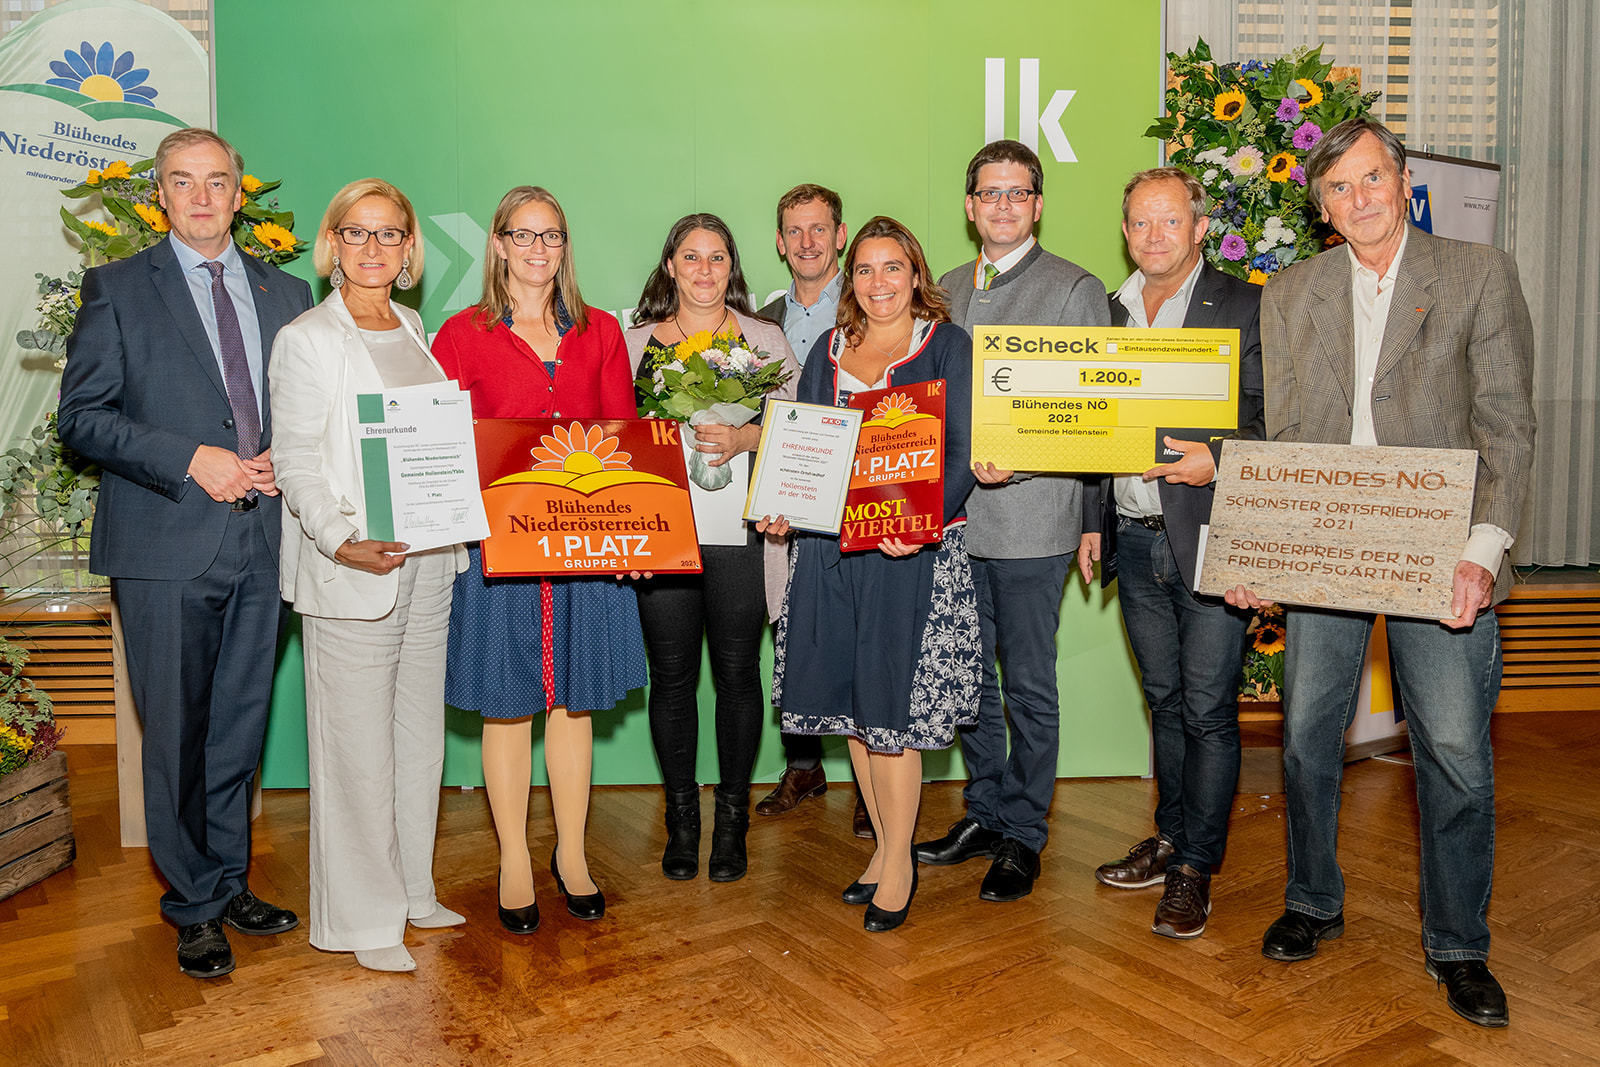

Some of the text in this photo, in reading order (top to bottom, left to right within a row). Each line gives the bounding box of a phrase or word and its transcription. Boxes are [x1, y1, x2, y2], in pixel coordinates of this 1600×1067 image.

[53, 120, 137, 151] Blühendes
[1005, 336, 1099, 354] Scheck
[1080, 371, 1140, 386] 1.200,-
[1012, 398, 1108, 411] Blühendes NÖ
[1048, 413, 1079, 424] 2021
[365, 426, 418, 435] Ehrenurkunde
[651, 421, 678, 445] lk
[871, 430, 917, 444] Blühendes
[1017, 427, 1108, 437] Gemeinde Hollenstein
[782, 442, 833, 456] EHRENURKUNDE
[868, 470, 915, 482] GRUPPE 1
[1240, 465, 1446, 491] BLÜHENDES NÖ
[780, 481, 818, 493] Hollenstein
[801, 492, 817, 501] Ybbs
[546, 500, 632, 514] Blühendes
[844, 498, 907, 522] MOST
[1326, 502, 1454, 521] ORTSFRIEDHOF
[508, 514, 671, 534] Niederösterreich
[843, 513, 939, 540] VIERTEL
[1312, 517, 1354, 530] 2021
[537, 535, 652, 557] 1.PLATZ
[1230, 539, 1355, 560] SONDERPREIS
[1361, 550, 1400, 564] DER
[564, 559, 629, 568] GRUPPE 1
[681, 560, 697, 568] 2021
